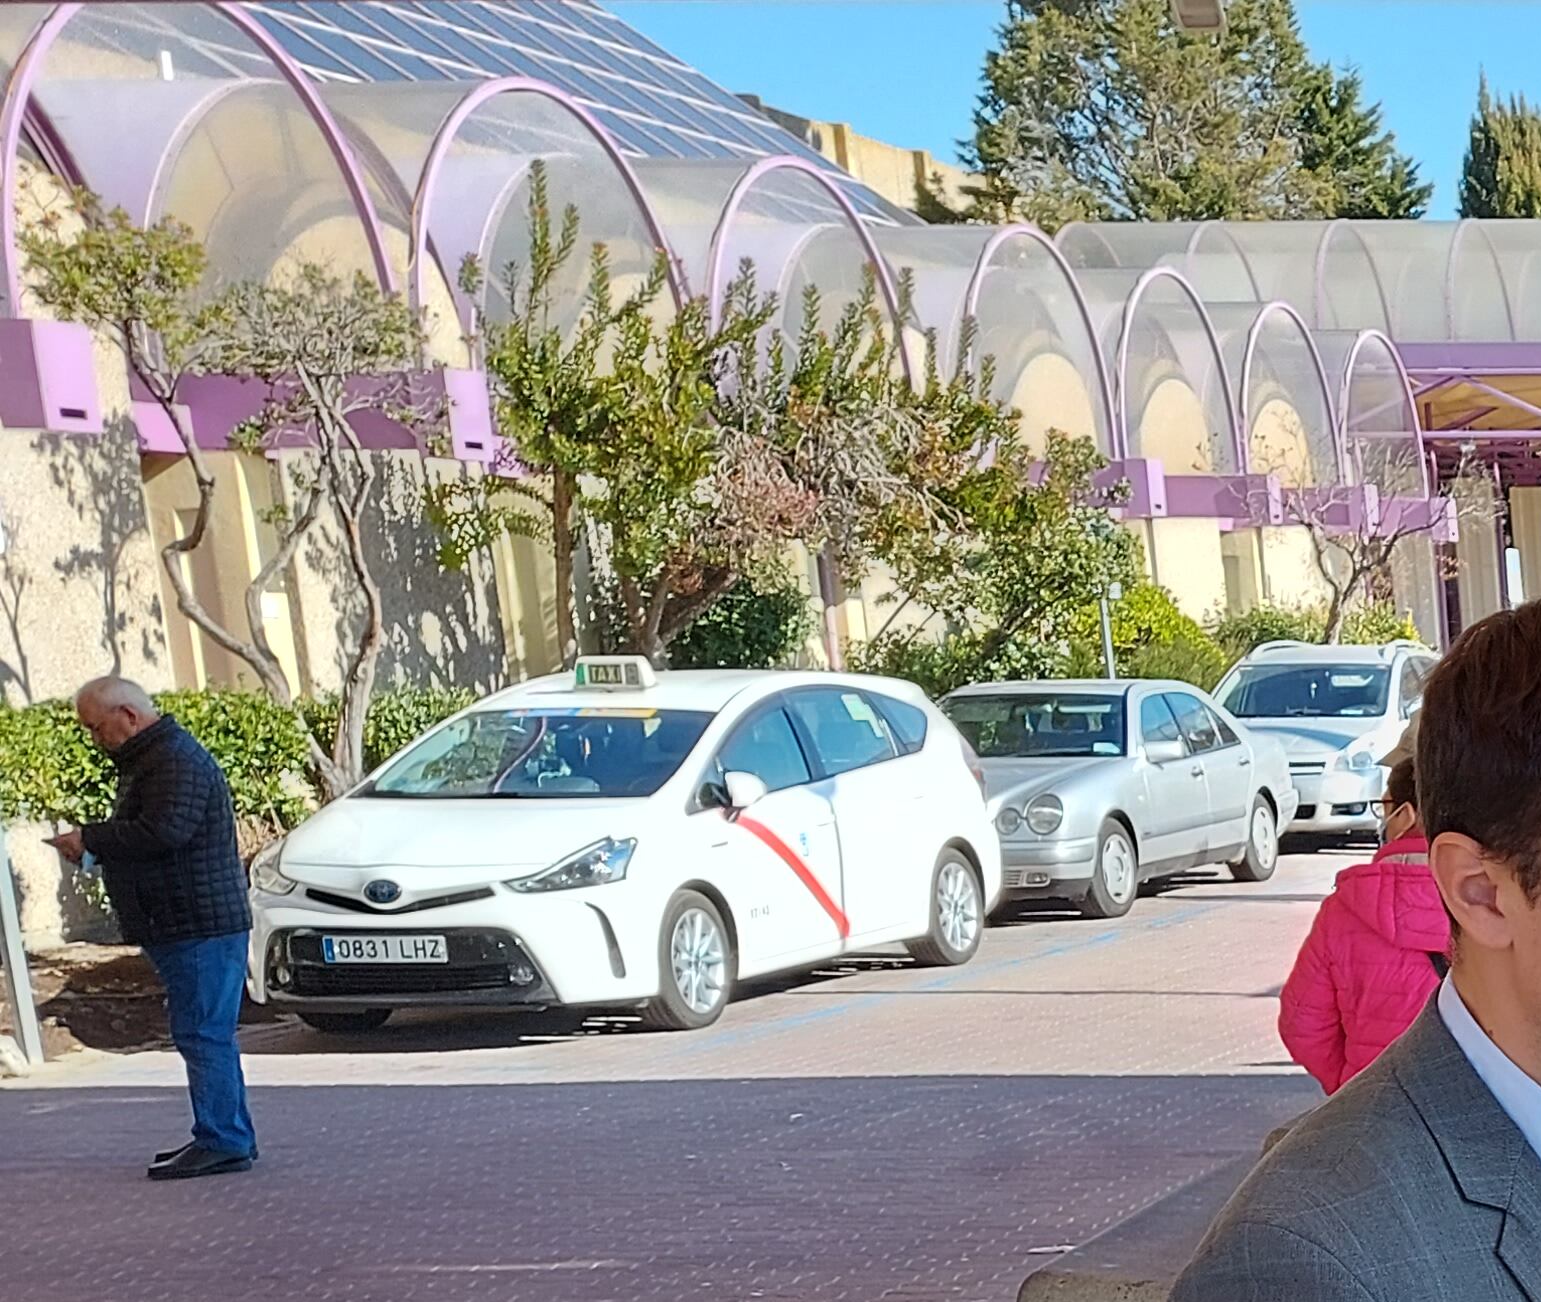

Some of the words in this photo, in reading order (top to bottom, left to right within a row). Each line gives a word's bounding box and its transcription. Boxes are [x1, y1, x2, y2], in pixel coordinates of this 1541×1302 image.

[590, 665, 621, 682] TAXI
[339, 939, 389, 959] 0831
[399, 939, 441, 959] LHZ
